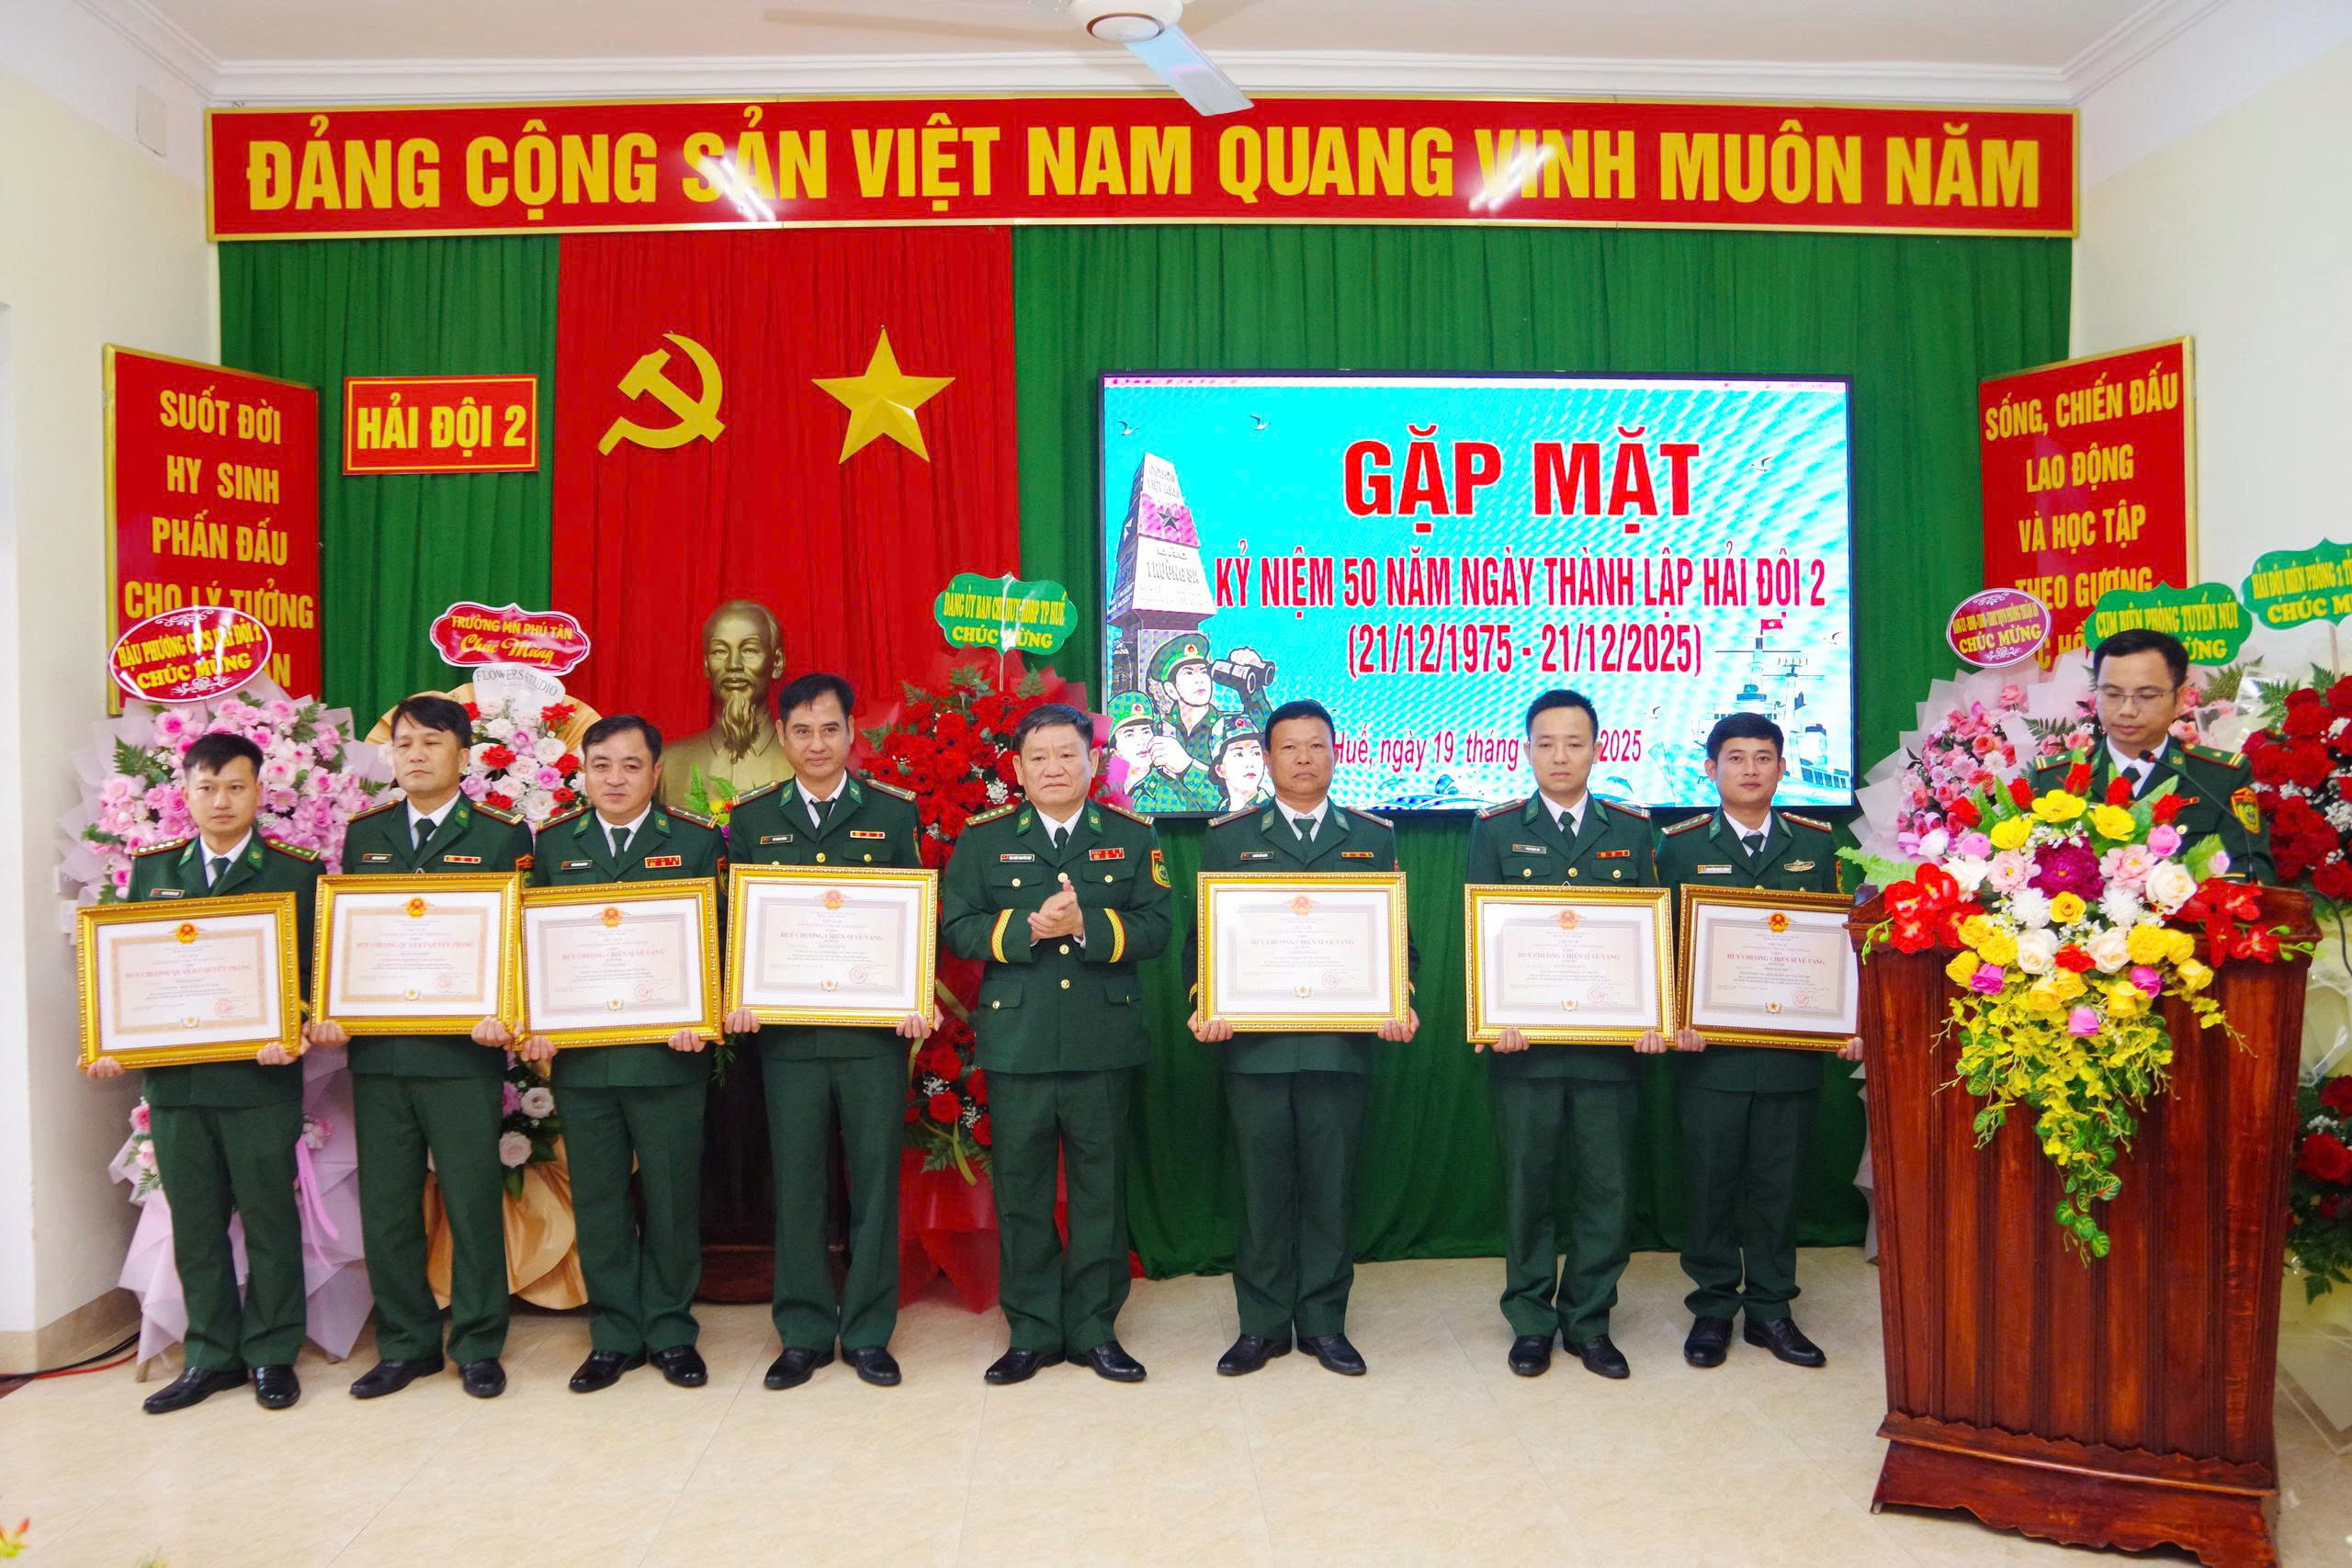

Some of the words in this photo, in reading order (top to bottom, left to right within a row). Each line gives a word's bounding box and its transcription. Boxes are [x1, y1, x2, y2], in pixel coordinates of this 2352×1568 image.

[246, 114, 439, 210] ĐẢNG
[466, 120, 656, 220] CỘNG
[682, 106, 827, 202] SẢN
[853, 113, 1000, 210] VIỆT
[1028, 126, 1192, 196] NAM
[1219, 126, 1453, 204] QUANG
[1475, 130, 1635, 199] VINH
[1661, 119, 1861, 203] MUÔN
[1886, 123, 2039, 208] NĂM
[161, 386, 229, 435] SUỐT
[238, 400, 280, 445] ĐỜI
[356, 392, 418, 449] HẢI
[429, 397, 492, 457] ĐỘI
[503, 405, 526, 447] 2
[1985, 394, 2048, 441] SỐNG,
[2056, 373, 2122, 427] CHIẾN
[2130, 363, 2178, 415] ĐẤU
[167, 456, 201, 493] HY
[217, 462, 279, 504] SINH
[1345, 425, 1501, 533] GẶP
[1533, 426, 1700, 534] MẶT
[2026, 455, 2065, 492] LAO
[2072, 442, 2133, 491] ĐỘNG
[153, 510, 228, 559] PHẤN
[237, 517, 288, 566] ĐẤU
[2018, 512, 2047, 553] VÀ
[2052, 512, 2096, 554] HỌC
[2103, 500, 2146, 548] TẬP
[125, 581, 181, 618] CHO
[231, 578, 314, 629] TƯỞNG
[1216, 540, 1250, 607] KỶ
[1261, 547, 1333, 618] NIỆM
[1344, 557, 1376, 607] 50
[1386, 544, 1451, 606] NĂM
[1461, 544, 1534, 607] NGÀY
[1544, 544, 1634, 606] THÀNH
[1644, 546, 1693, 618] LẬP
[1703, 540, 1747, 606] HẢI
[1756, 547, 1800, 618] ĐỘI
[1810, 558, 1826, 606] 2
[450, 615, 501, 632] TRƯỜNG
[502, 620, 521, 635] MN
[523, 621, 548, 636] PHÚ
[549, 624, 573, 640] TÂN
[2267, 595, 2327, 624] CHÚC
[186, 629, 214, 654] CCS
[952, 625, 999, 644] CHÚC
[1002, 627, 1053, 648] ỪNG
[1349, 623, 1512, 678] (21/12/1975
[1542, 623, 1702, 678] 21/12/2025)
[1960, 631, 1996, 654] CHÚC
[1997, 624, 2041, 647] MỪNG
[2183, 636, 2228, 660] ỪNG
[137, 662, 191, 689] CHÚC
[476, 668, 524, 682] FLOWERS
[525, 672, 559, 696] STUDIO
[1334, 723, 1373, 769] Huế,
[1380, 730, 1426, 773] ngày
[1434, 730, 1454, 763] 19
[1466, 730, 1519, 772] tháng
[1600, 729, 1642, 761] 2025
